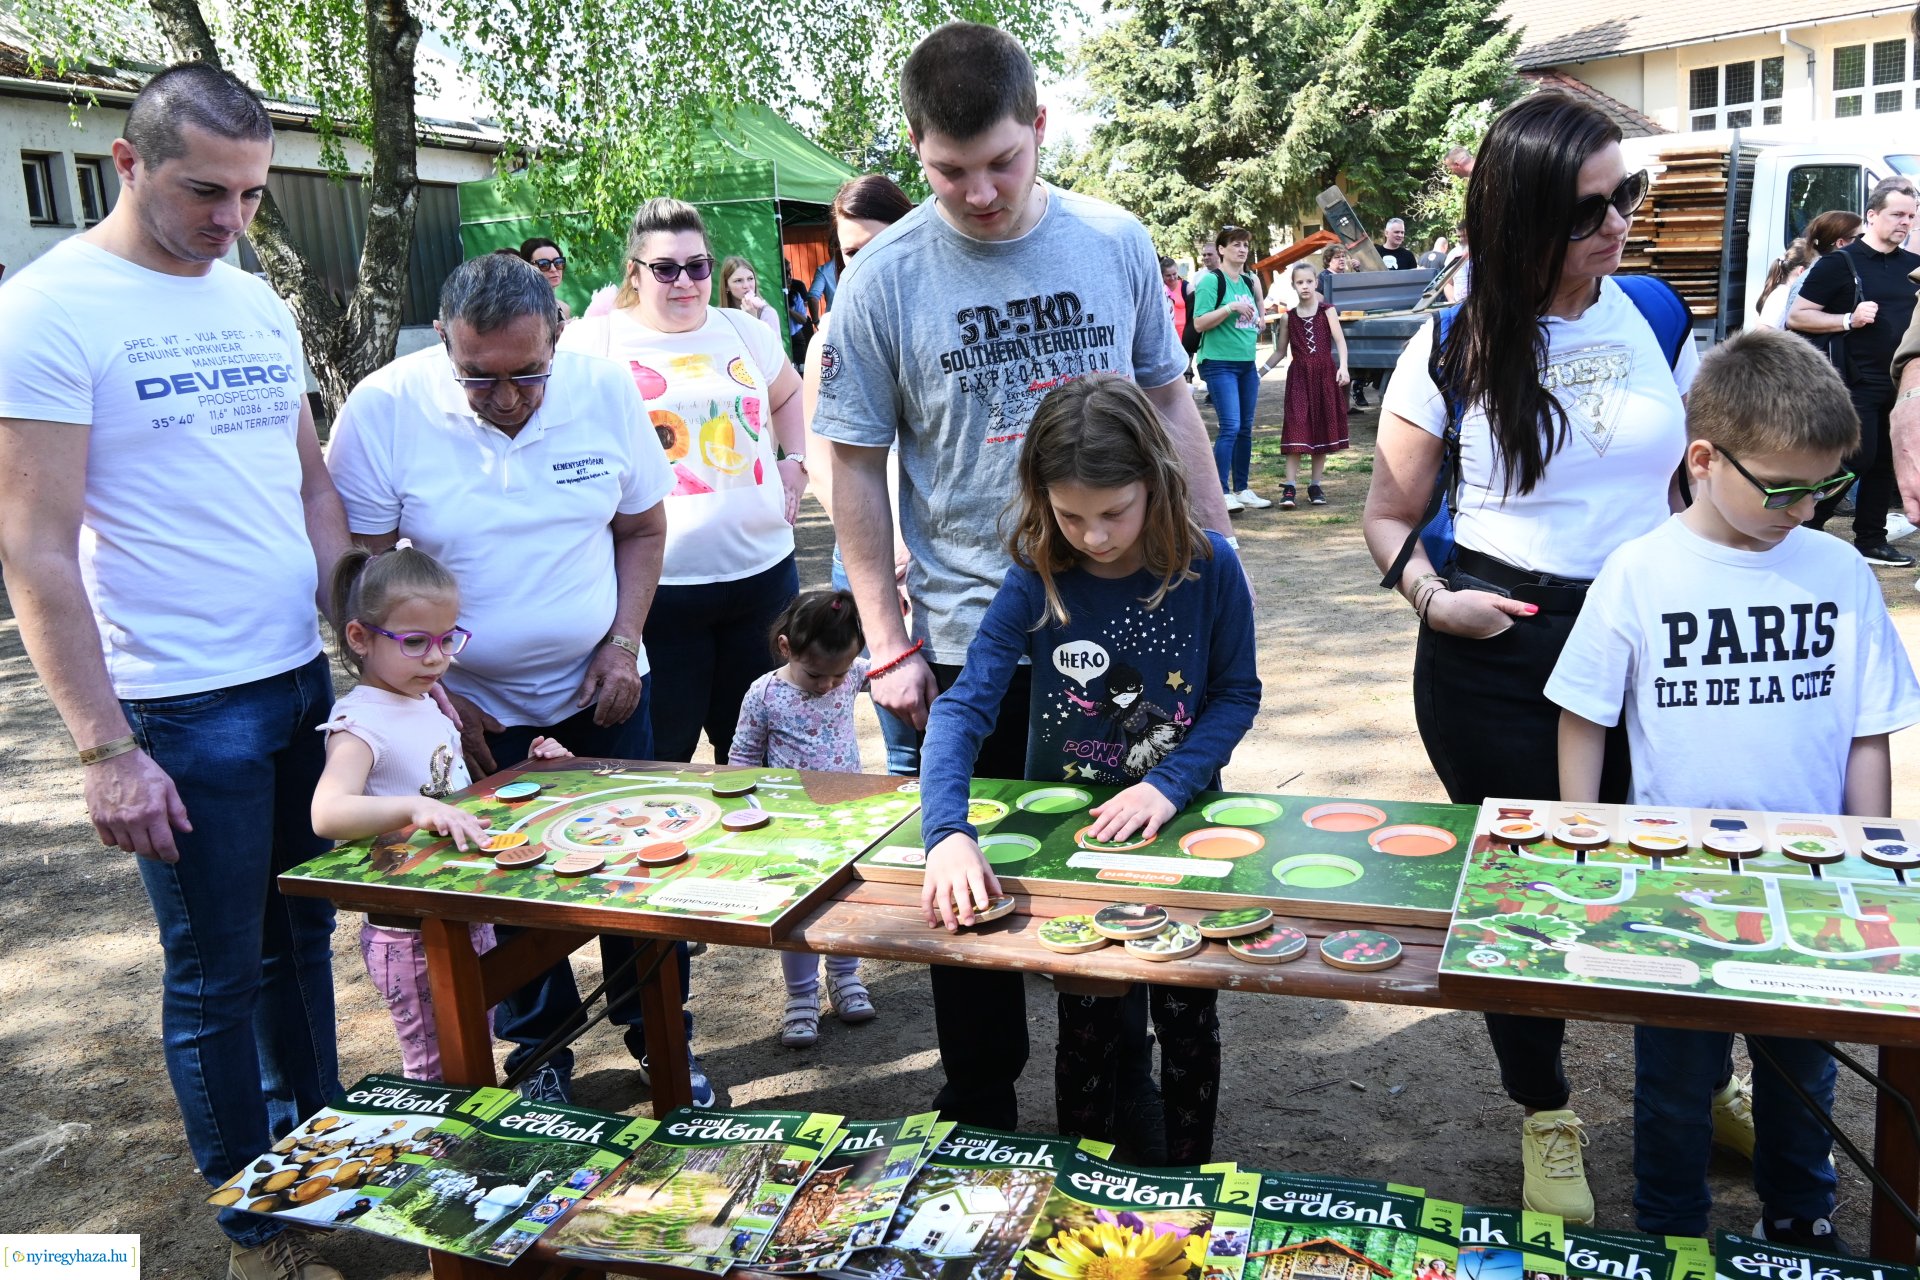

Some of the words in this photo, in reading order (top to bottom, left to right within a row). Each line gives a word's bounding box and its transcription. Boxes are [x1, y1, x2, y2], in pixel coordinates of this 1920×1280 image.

[124, 338, 158, 351] SPEC.
[162, 335, 179, 345] WT
[195, 332, 217, 342] VUA
[221, 330, 246, 340] SPEC
[940, 337, 1031, 375] SOUTHERN
[1030, 325, 1115, 357] TERRITORY
[128, 347, 182, 363] GENUINE
[183, 342, 243, 357] WORKWEAR
[192, 353, 269, 368] MANUFACTURED
[270, 352, 283, 362] FOR
[198, 386, 285, 408] PROSPECTORS
[152, 415, 176, 429] 35°
[274, 402, 289, 412] 520
[210, 421, 243, 435] URBAN
[244, 414, 291, 431] TERRITORY
[1661, 601, 1839, 668] PARIS
[1059, 649, 1104, 670] HERO
[1654, 676, 1698, 708] ÎLE
[1705, 678, 1740, 706] DE
[1749, 675, 1785, 704] LA
[1792, 664, 1836, 702] CITÉ
[1063, 739, 1123, 767] POW!
[347, 1089, 452, 1113] erdőnk
[499, 1114, 606, 1144] erdőnk
[666, 1119, 784, 1141] erdőnk
[803, 1128, 822, 1142] 4
[905, 1125, 923, 1139] 5
[618, 1133, 640, 1148] 3
[937, 1139, 1054, 1168] erdőnk
[1067, 1172, 1206, 1207] erdőnk
[1229, 1190, 1250, 1205] 2
[1259, 1193, 1407, 1229] erdőnk
[1431, 1216, 1453, 1235] 3
[1530, 1230, 1556, 1249] 4
